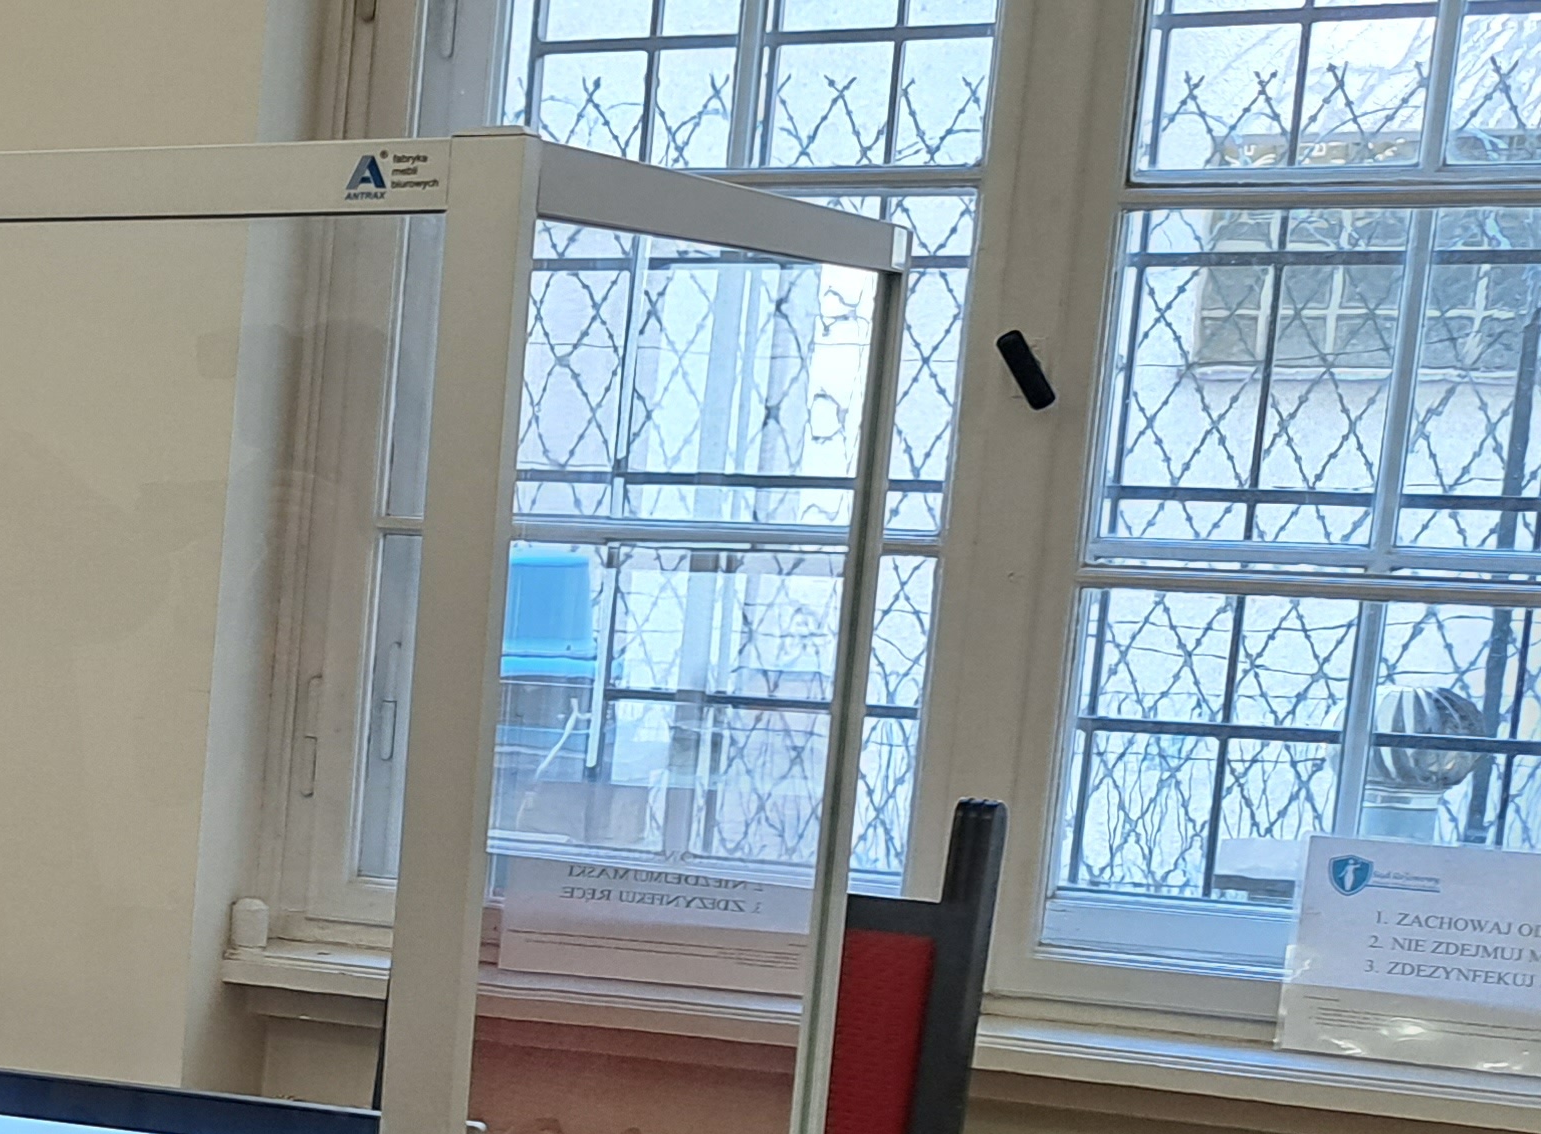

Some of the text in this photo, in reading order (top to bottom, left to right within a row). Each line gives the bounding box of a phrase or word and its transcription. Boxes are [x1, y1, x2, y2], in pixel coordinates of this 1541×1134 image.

[1395, 912, 1512, 935] ZACHOWAJ
[1391, 936, 1427, 953] NIE
[1430, 940, 1524, 961] ZDEJMUJ
[1386, 961, 1535, 988] ZDEZYNFEKUJ
